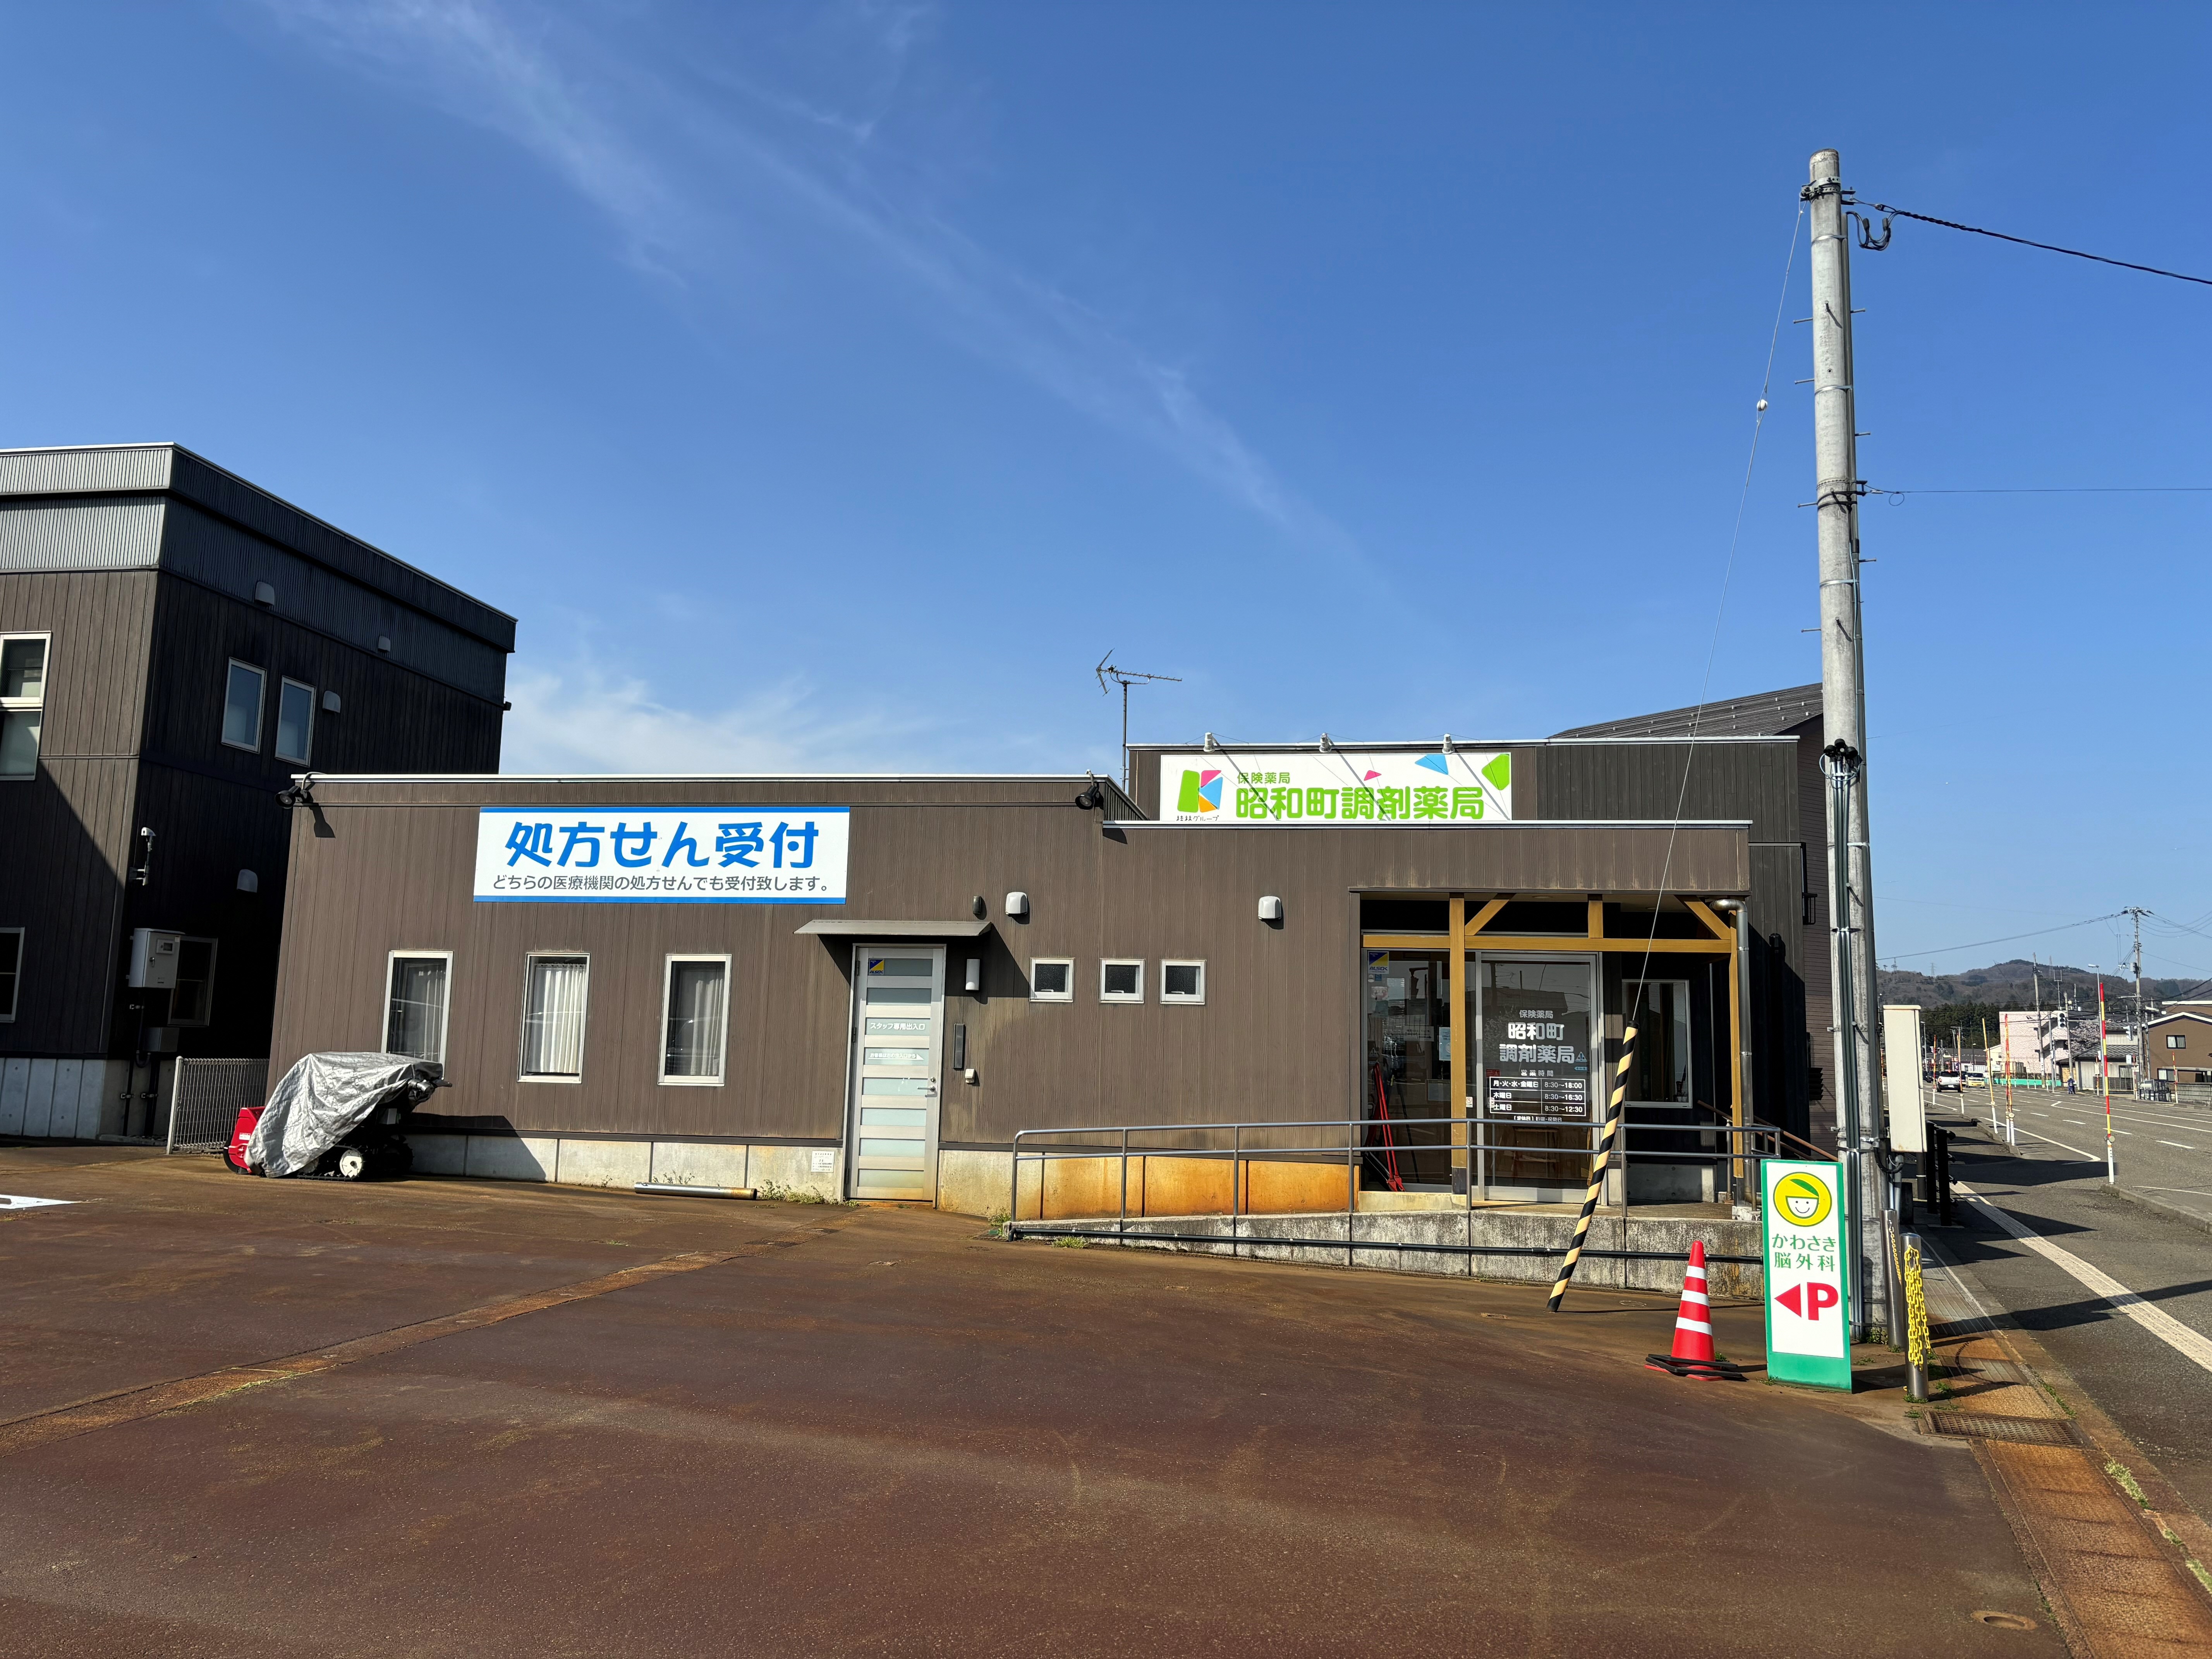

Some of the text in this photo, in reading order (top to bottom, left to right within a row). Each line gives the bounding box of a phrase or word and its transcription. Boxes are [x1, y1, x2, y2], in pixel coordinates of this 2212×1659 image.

[1237, 772, 1290, 785] 保険薬局
[1236, 786, 1484, 820] 昭和町調剤薬局
[505, 821, 819, 868] 処方せん受付
[493, 874, 827, 892] どちらの医療機関の処方せんでも受付致します。
[1519, 1010, 1553, 1019] 保険薬局
[1508, 1022, 1565, 1041] 昭和町
[1499, 1044, 1575, 1064] 調剤薬局
[1772, 1233, 1836, 1252] かわさき
[1775, 1252, 1835, 1271] 脳外科
[1807, 1282, 1839, 1321] P
